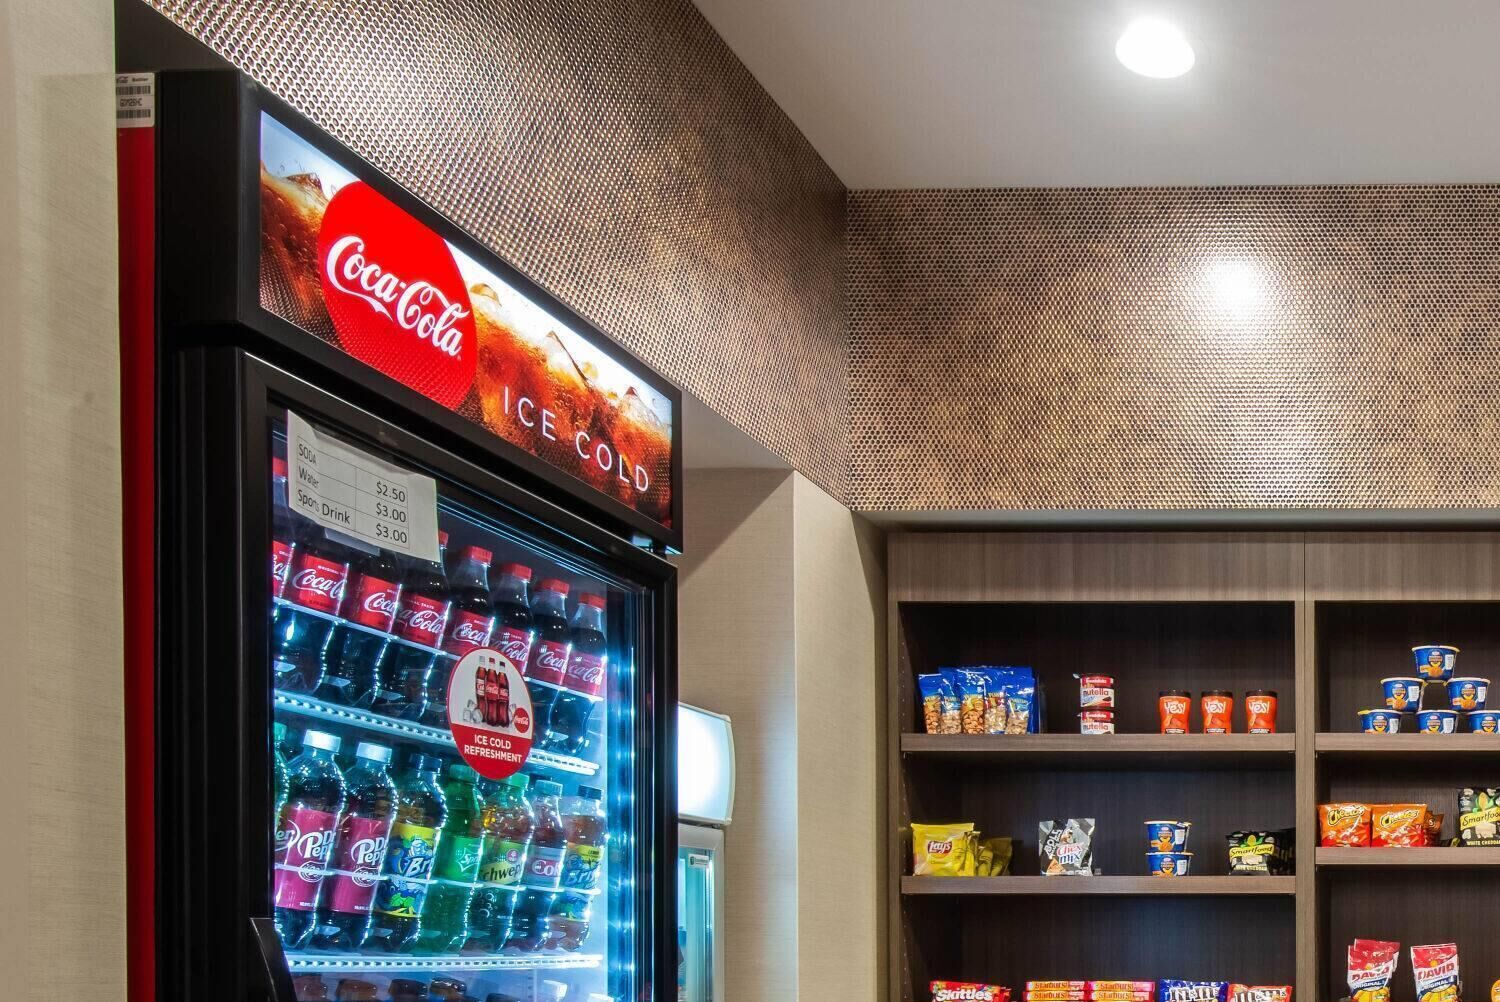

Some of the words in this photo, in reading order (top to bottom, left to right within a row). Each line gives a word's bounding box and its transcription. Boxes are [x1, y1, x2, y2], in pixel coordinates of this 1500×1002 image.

[326, 235, 470, 361] Coca-Cola
[504, 387, 556, 441] ICE
[576, 431, 649, 493] COLD
[299, 444, 317, 464] SODA
[376, 481, 406, 503] $2.50
[299, 466, 319, 489] Water
[376, 503, 407, 523] $3.00
[298, 490, 320, 513] Sports
[322, 504, 350, 525] Drink
[376, 523, 408, 544] $3.00
[1083, 688, 1109, 697] nutella
[1083, 723, 1109, 731] nutella
[474, 734, 488, 746] ICE
[490, 738, 512, 750] COLD
[464, 745, 523, 763] REFRESHMENT
[1230, 844, 1273, 857] Smartfood
[1417, 962, 1455, 980] DAVID
[935, 988, 993, 1002] Skittles
